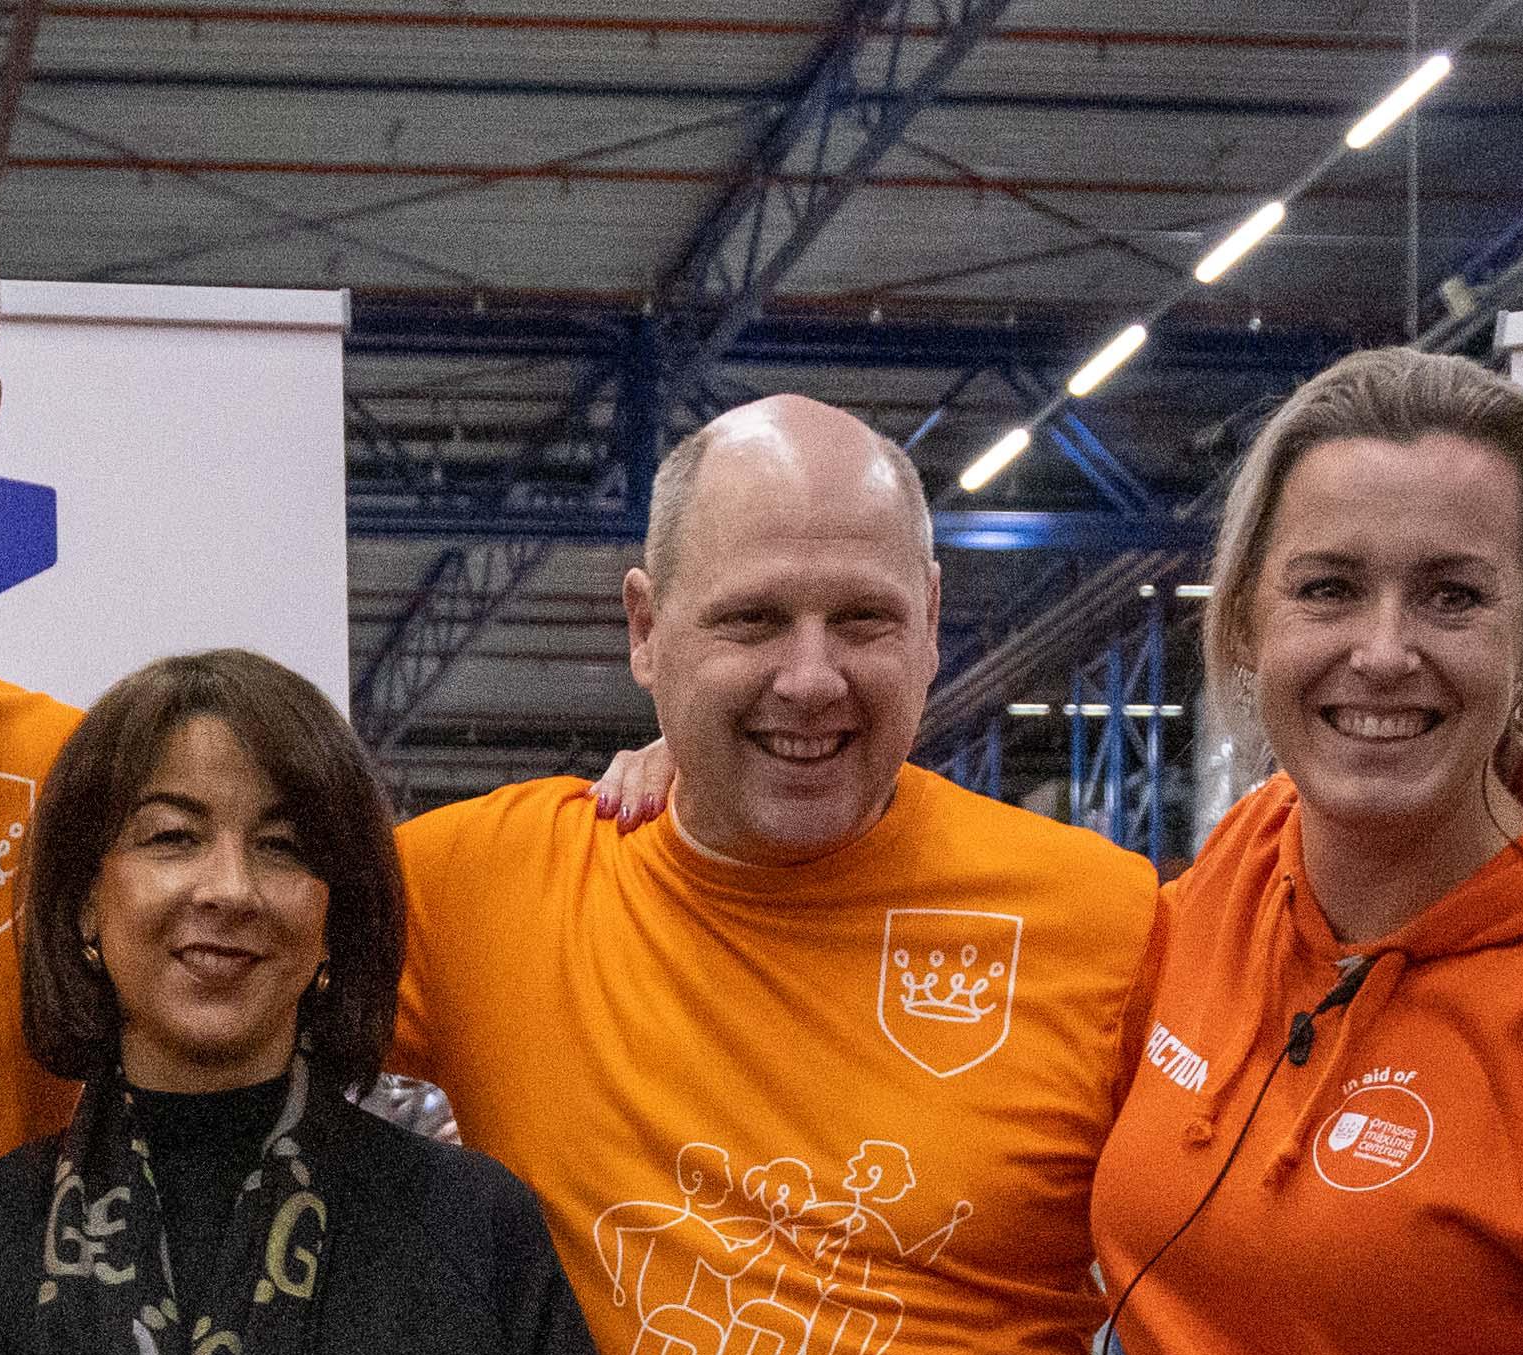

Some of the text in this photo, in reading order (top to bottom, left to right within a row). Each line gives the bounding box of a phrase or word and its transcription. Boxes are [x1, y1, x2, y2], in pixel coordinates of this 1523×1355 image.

[1148, 1024, 1209, 1095] ACTION
[1362, 1066, 1391, 1084] aid
[1394, 1070, 1418, 1084] of
